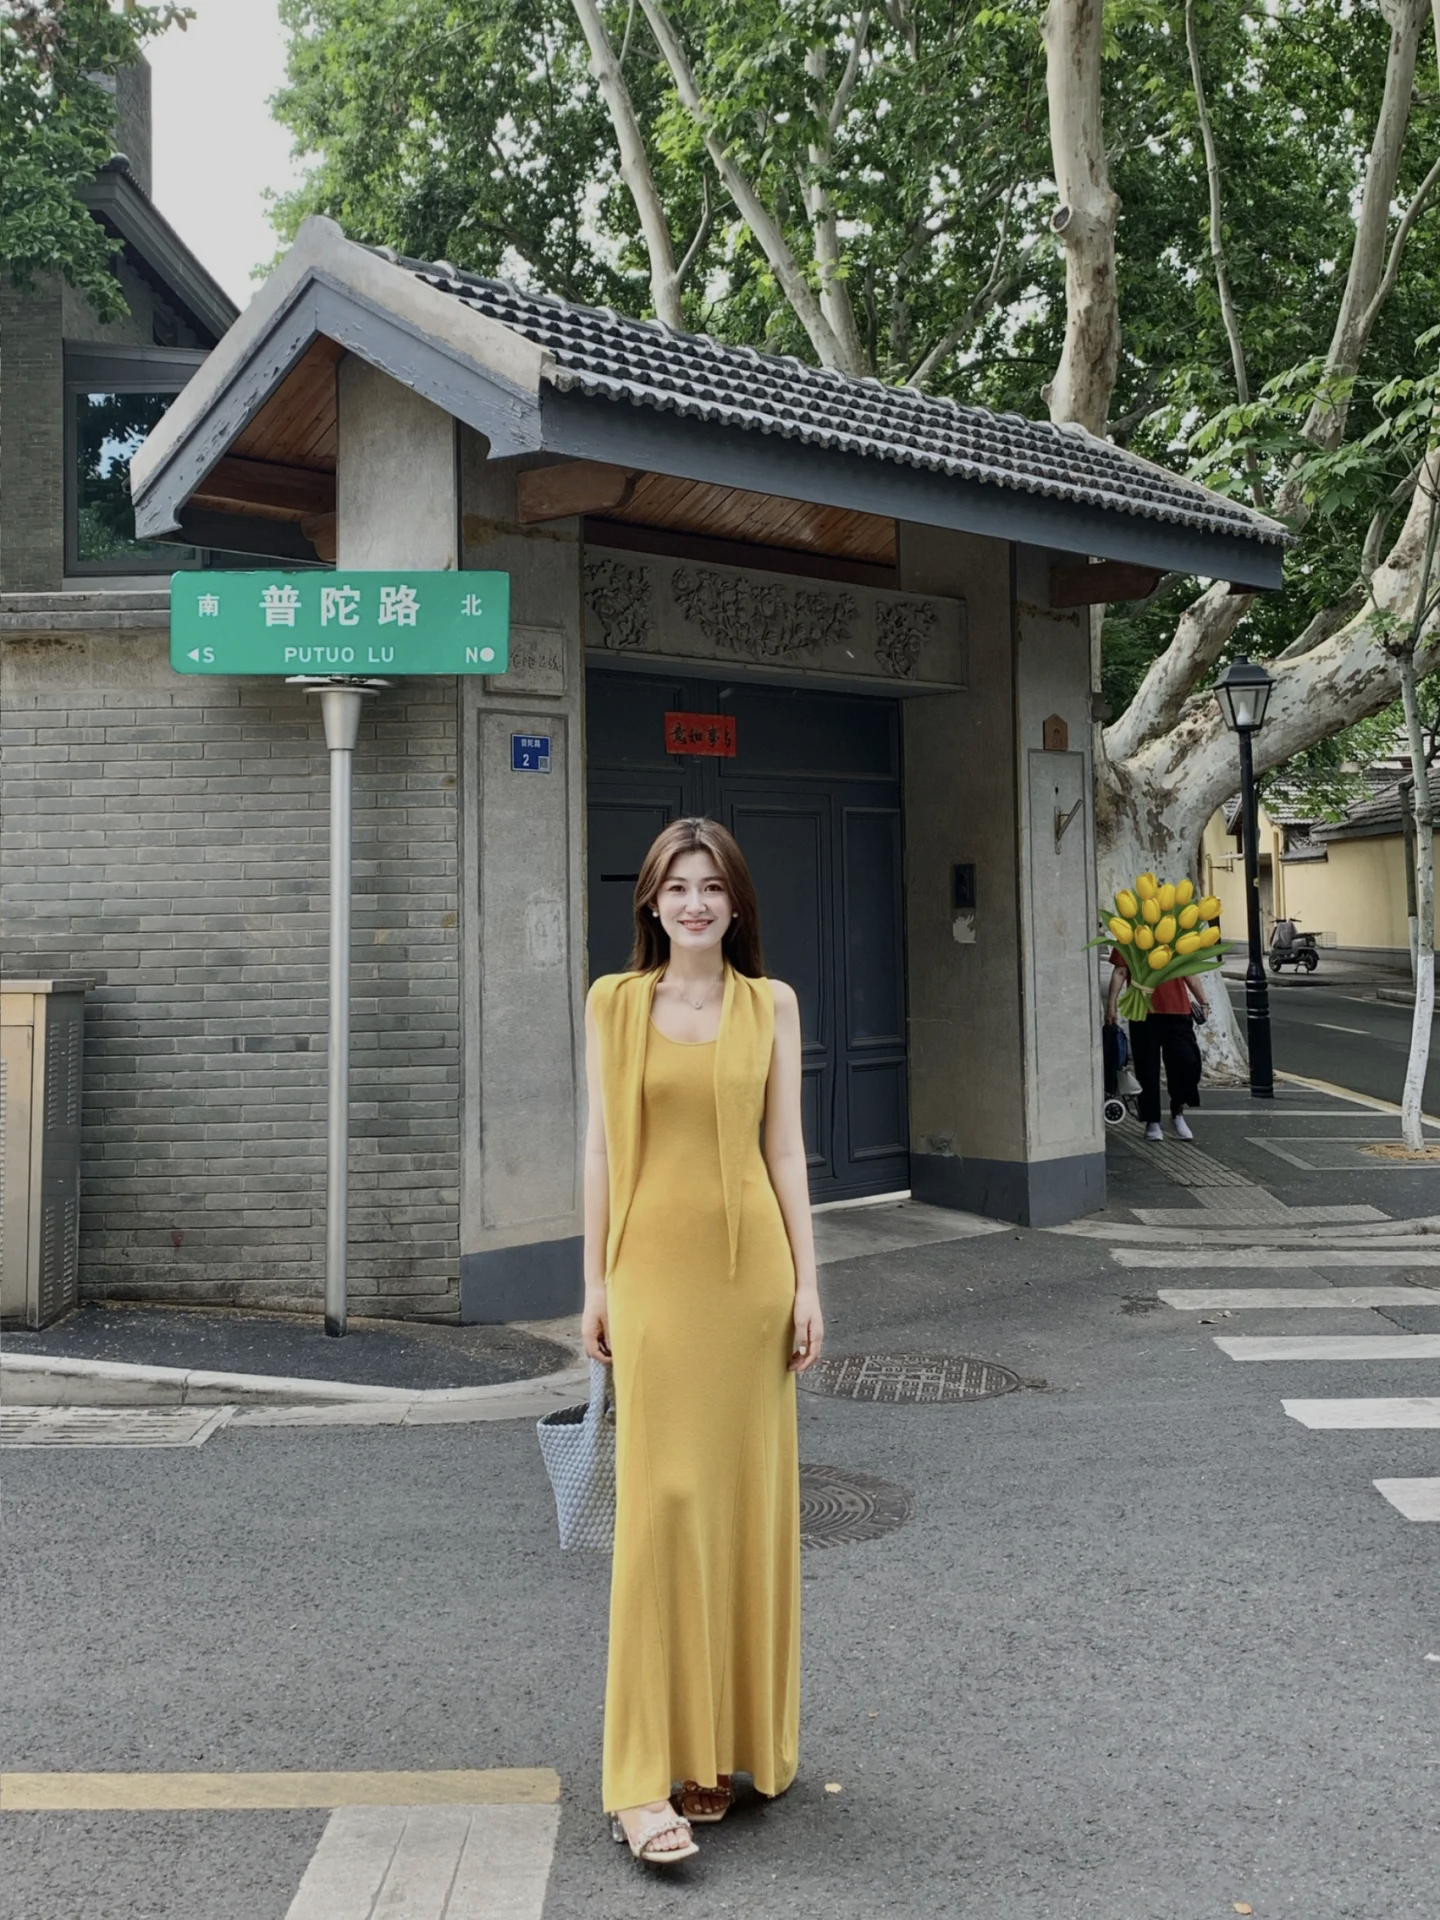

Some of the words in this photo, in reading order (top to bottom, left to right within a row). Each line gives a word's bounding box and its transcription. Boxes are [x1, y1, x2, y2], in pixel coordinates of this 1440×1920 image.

[199, 593, 219, 617] 南
[259, 584, 420, 627] 普陀路
[461, 594, 482, 616] 北
[203, 647, 215, 663] S
[285, 647, 354, 663] PUTUO
[368, 647, 394, 662] LU
[466, 647, 478, 663] N
[522, 753, 530, 767] 2
